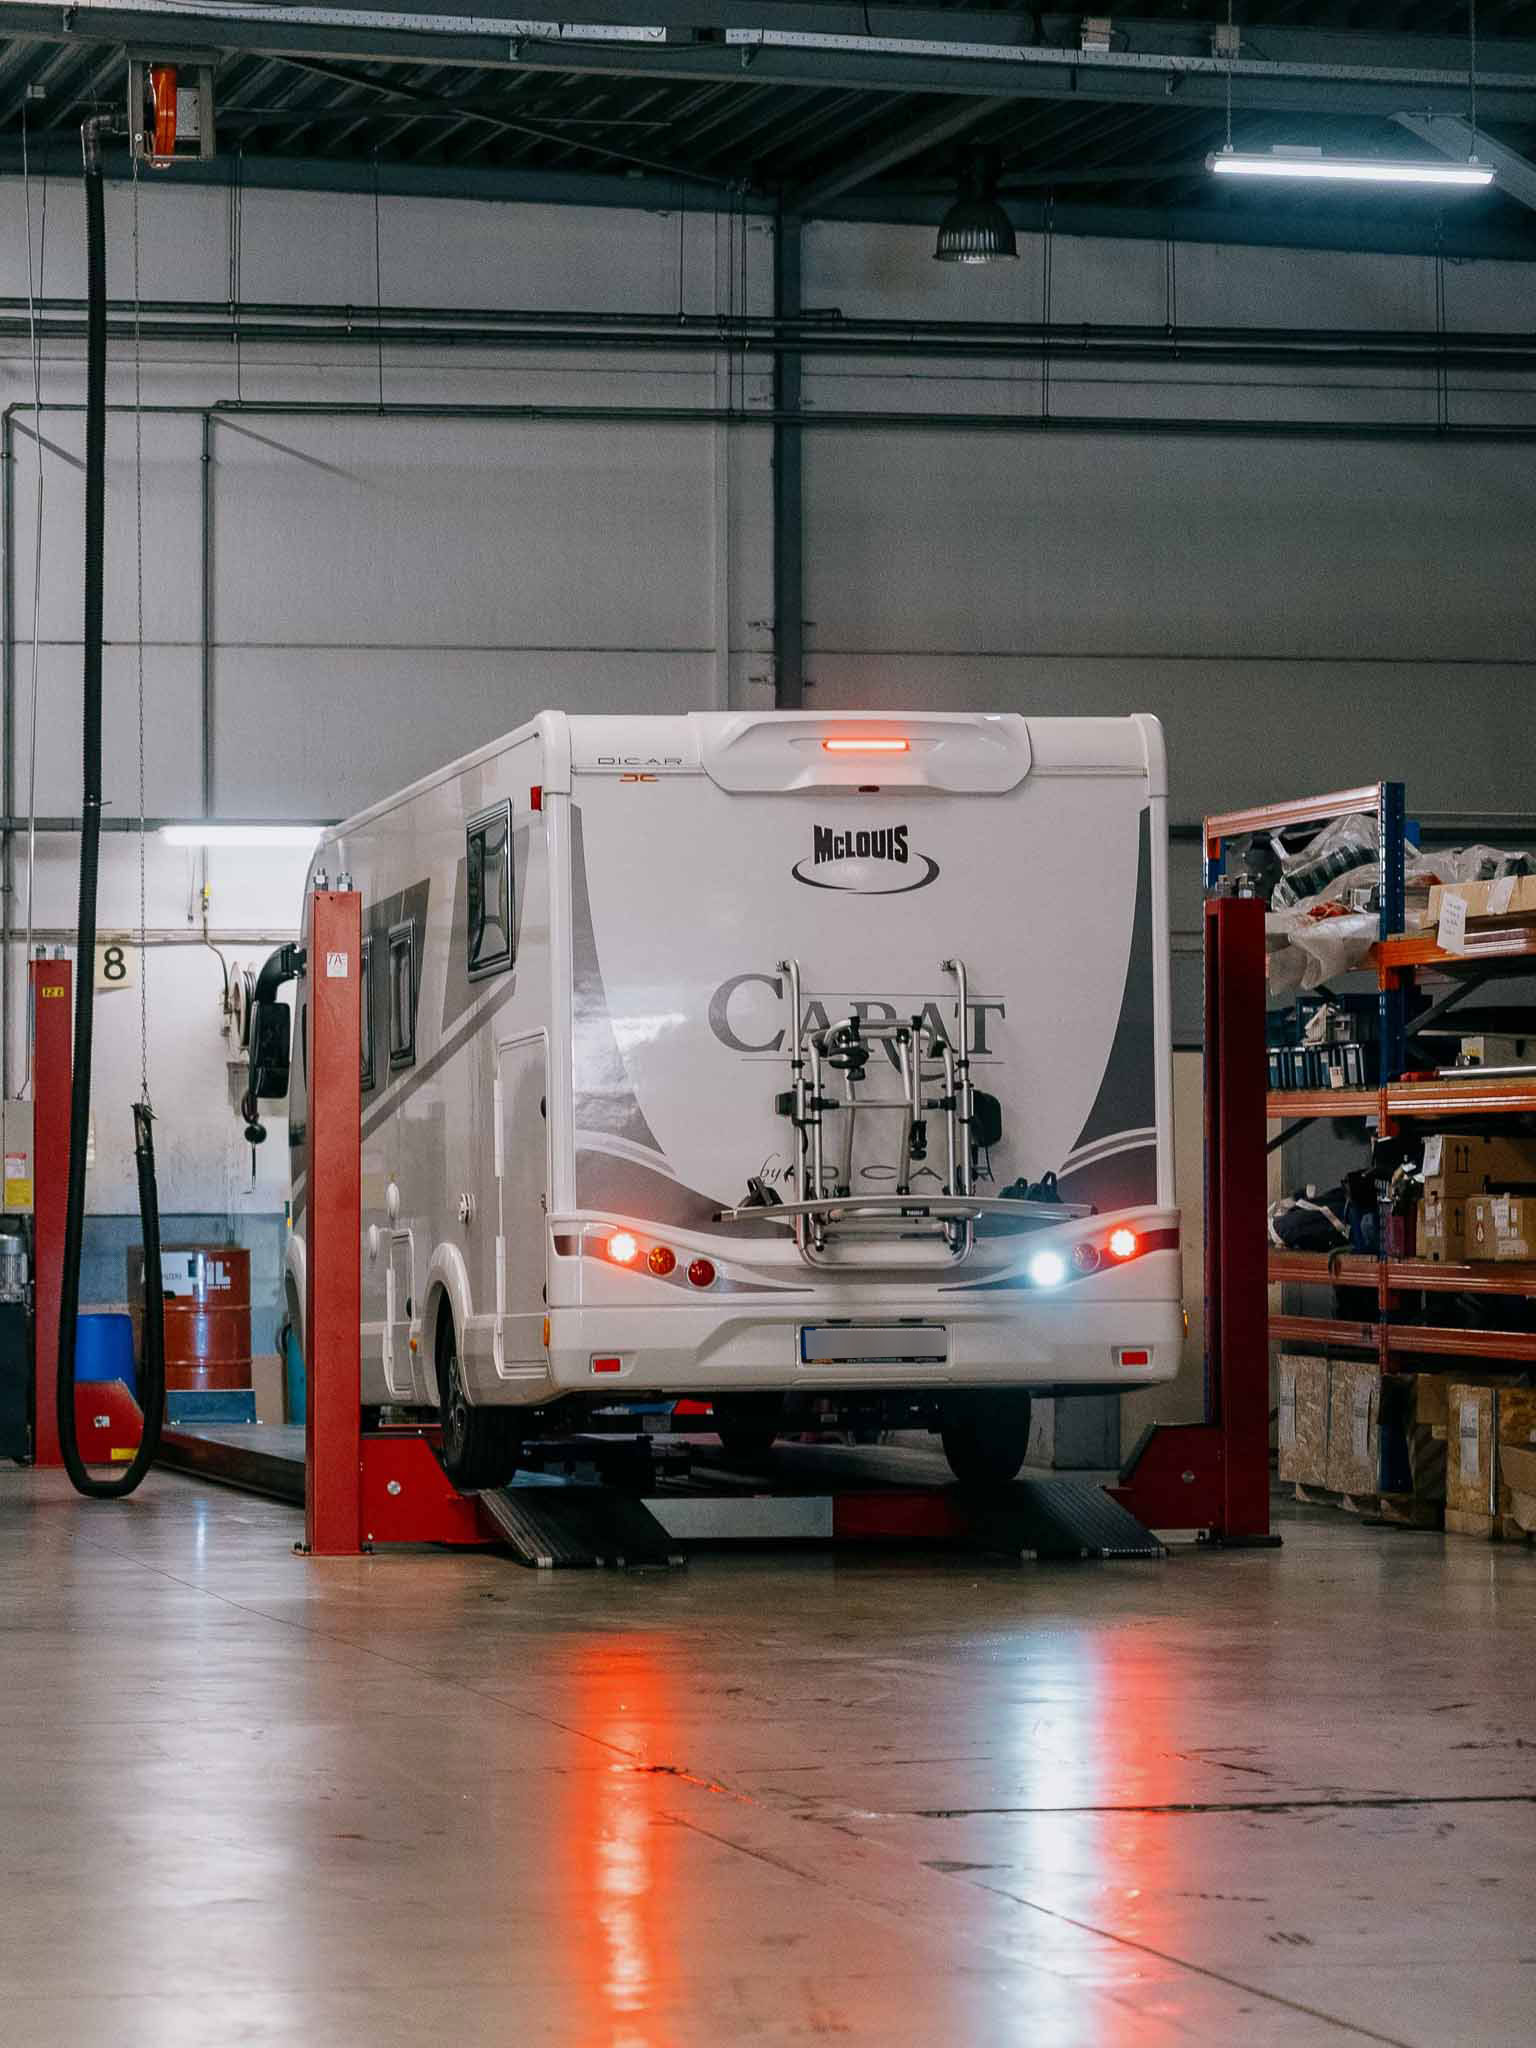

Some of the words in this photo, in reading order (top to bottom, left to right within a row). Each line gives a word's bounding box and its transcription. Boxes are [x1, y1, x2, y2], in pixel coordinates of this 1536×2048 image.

[598, 757, 682, 765] DICAR
[814, 824, 908, 864] McLOUIS
[104, 947, 126, 980] 8
